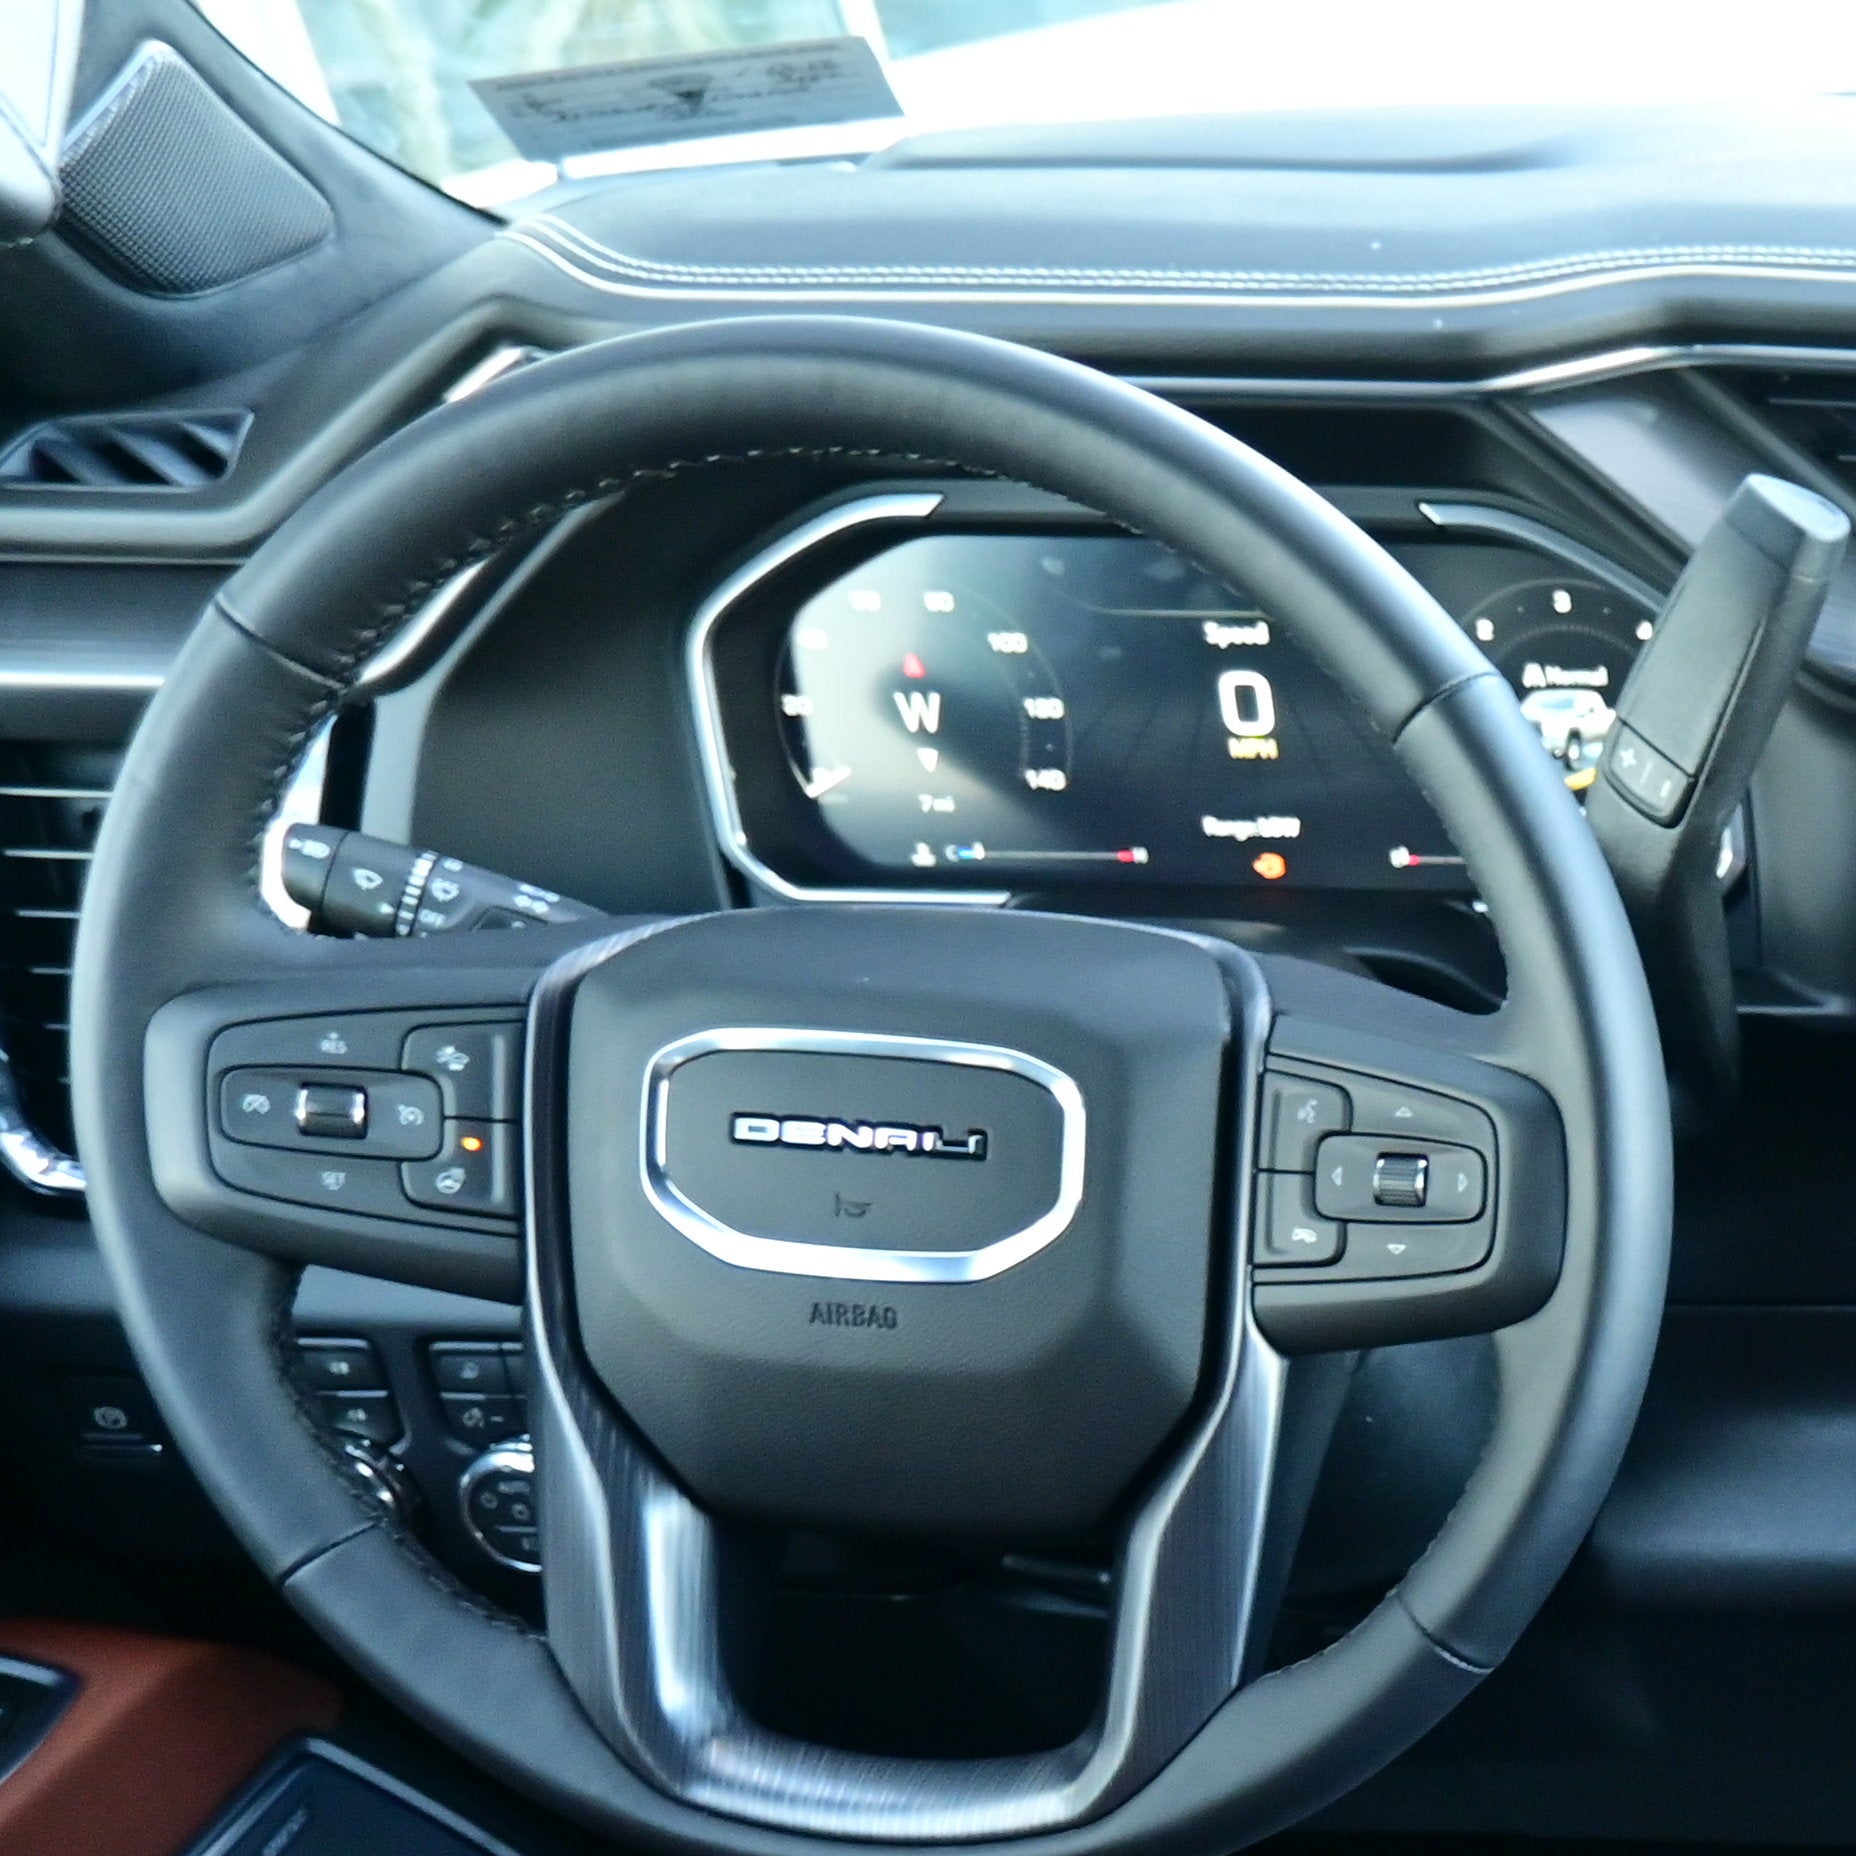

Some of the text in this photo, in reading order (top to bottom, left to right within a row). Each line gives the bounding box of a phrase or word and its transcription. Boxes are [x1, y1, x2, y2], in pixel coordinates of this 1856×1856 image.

[988, 633, 1028, 653] 100
[1203, 620, 1269, 648] Speed
[893, 691, 940, 733] W
[1217, 669, 1276, 737] 0
[731, 1115, 986, 1157] DENALI
[809, 1302, 899, 1330] AIRBAG
